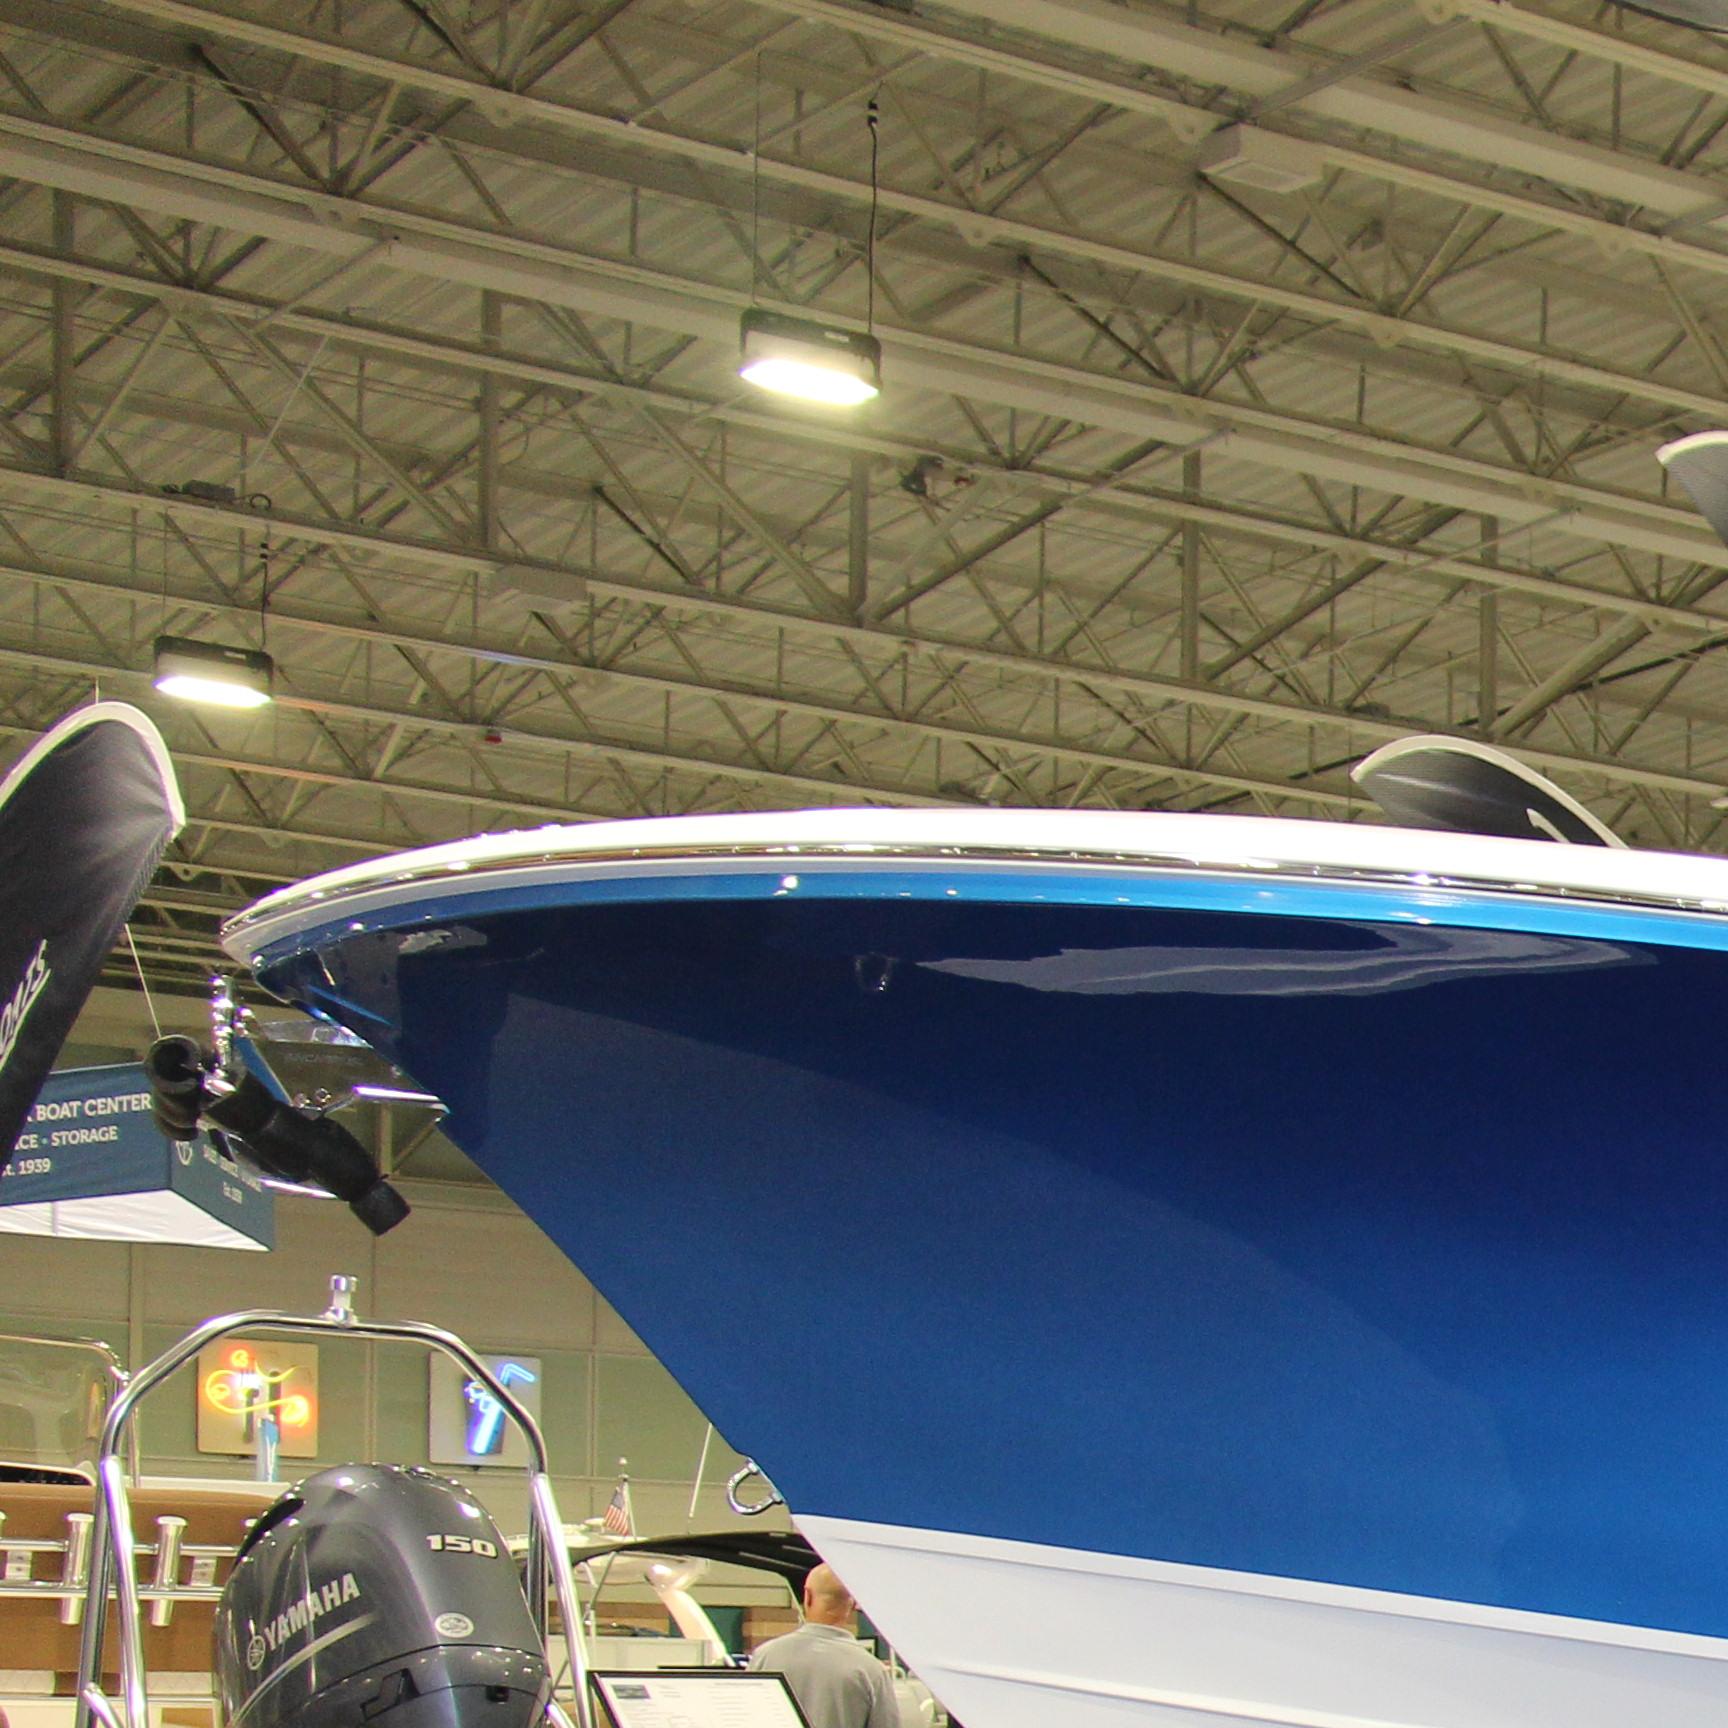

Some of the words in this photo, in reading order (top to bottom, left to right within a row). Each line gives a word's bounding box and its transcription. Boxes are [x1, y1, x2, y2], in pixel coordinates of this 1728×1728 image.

[35, 1100, 81, 1121] BOAT
[84, 1093, 153, 1117] CENTER
[51, 1125, 119, 1147] STORAGE
[18, 1158, 51, 1176] 1939
[425, 1533, 499, 1560] 150
[263, 1572, 362, 1652] YAMAHA
